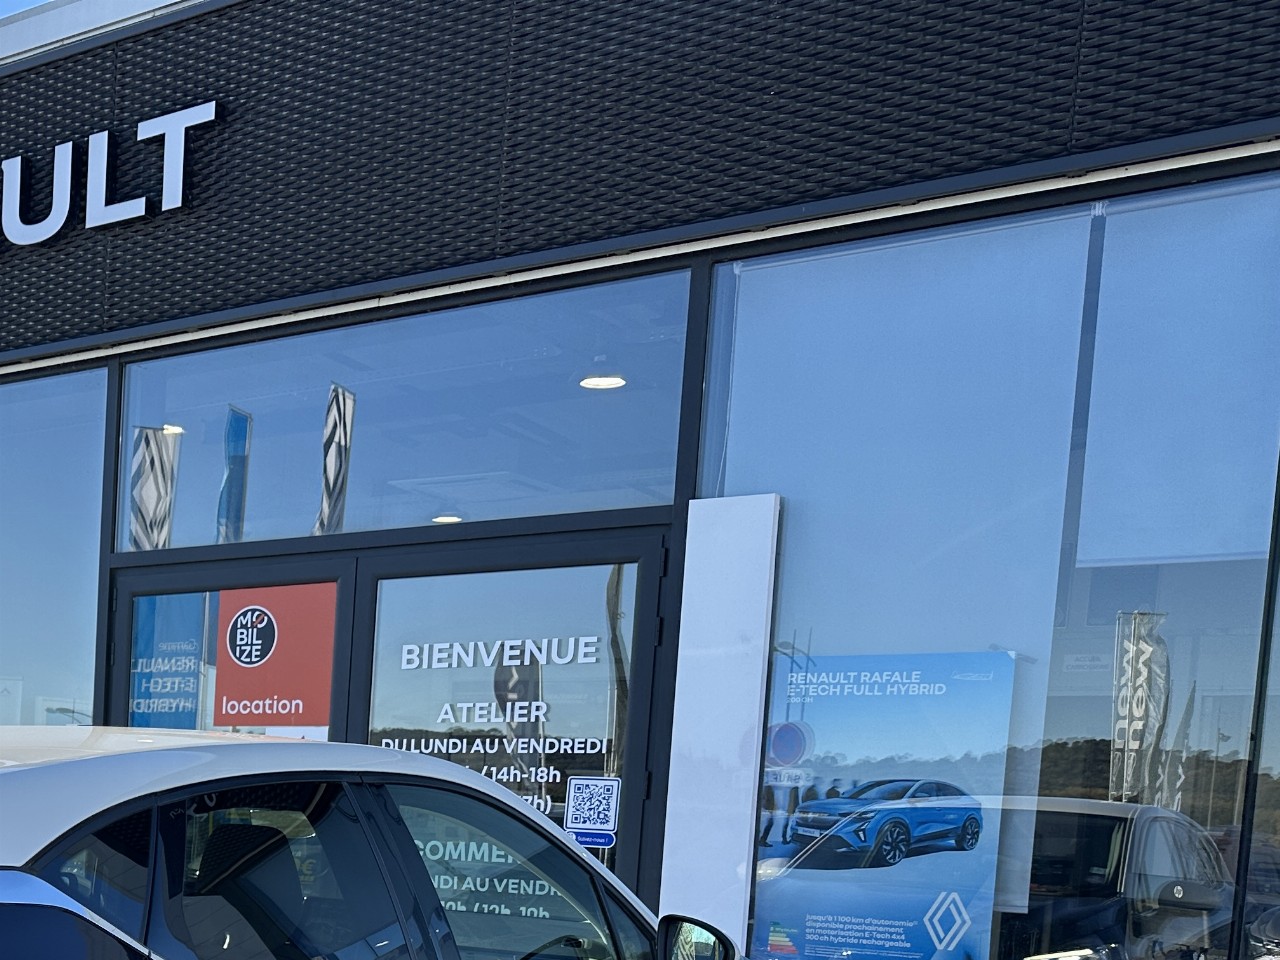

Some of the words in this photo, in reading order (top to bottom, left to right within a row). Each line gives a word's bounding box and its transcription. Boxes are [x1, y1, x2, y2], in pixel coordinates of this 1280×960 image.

[236, 628, 263, 645] BIL
[236, 645, 262, 662] IZE
[401, 636, 598, 670] BIENVENUE
[787, 672, 857, 684] RENAULT
[860, 671, 922, 683] RAFALE
[787, 684, 840, 696] E-TECH
[844, 684, 882, 696] FULL
[886, 683, 946, 695] HYBRID
[222, 695, 303, 714] location
[437, 701, 548, 723] ATELIER
[381, 738, 407, 751] DU
[410, 738, 467, 754] LUNDI
[470, 738, 499, 754] AU
[502, 738, 607, 754] VENDREDI
[461, 877, 489, 892] AU
